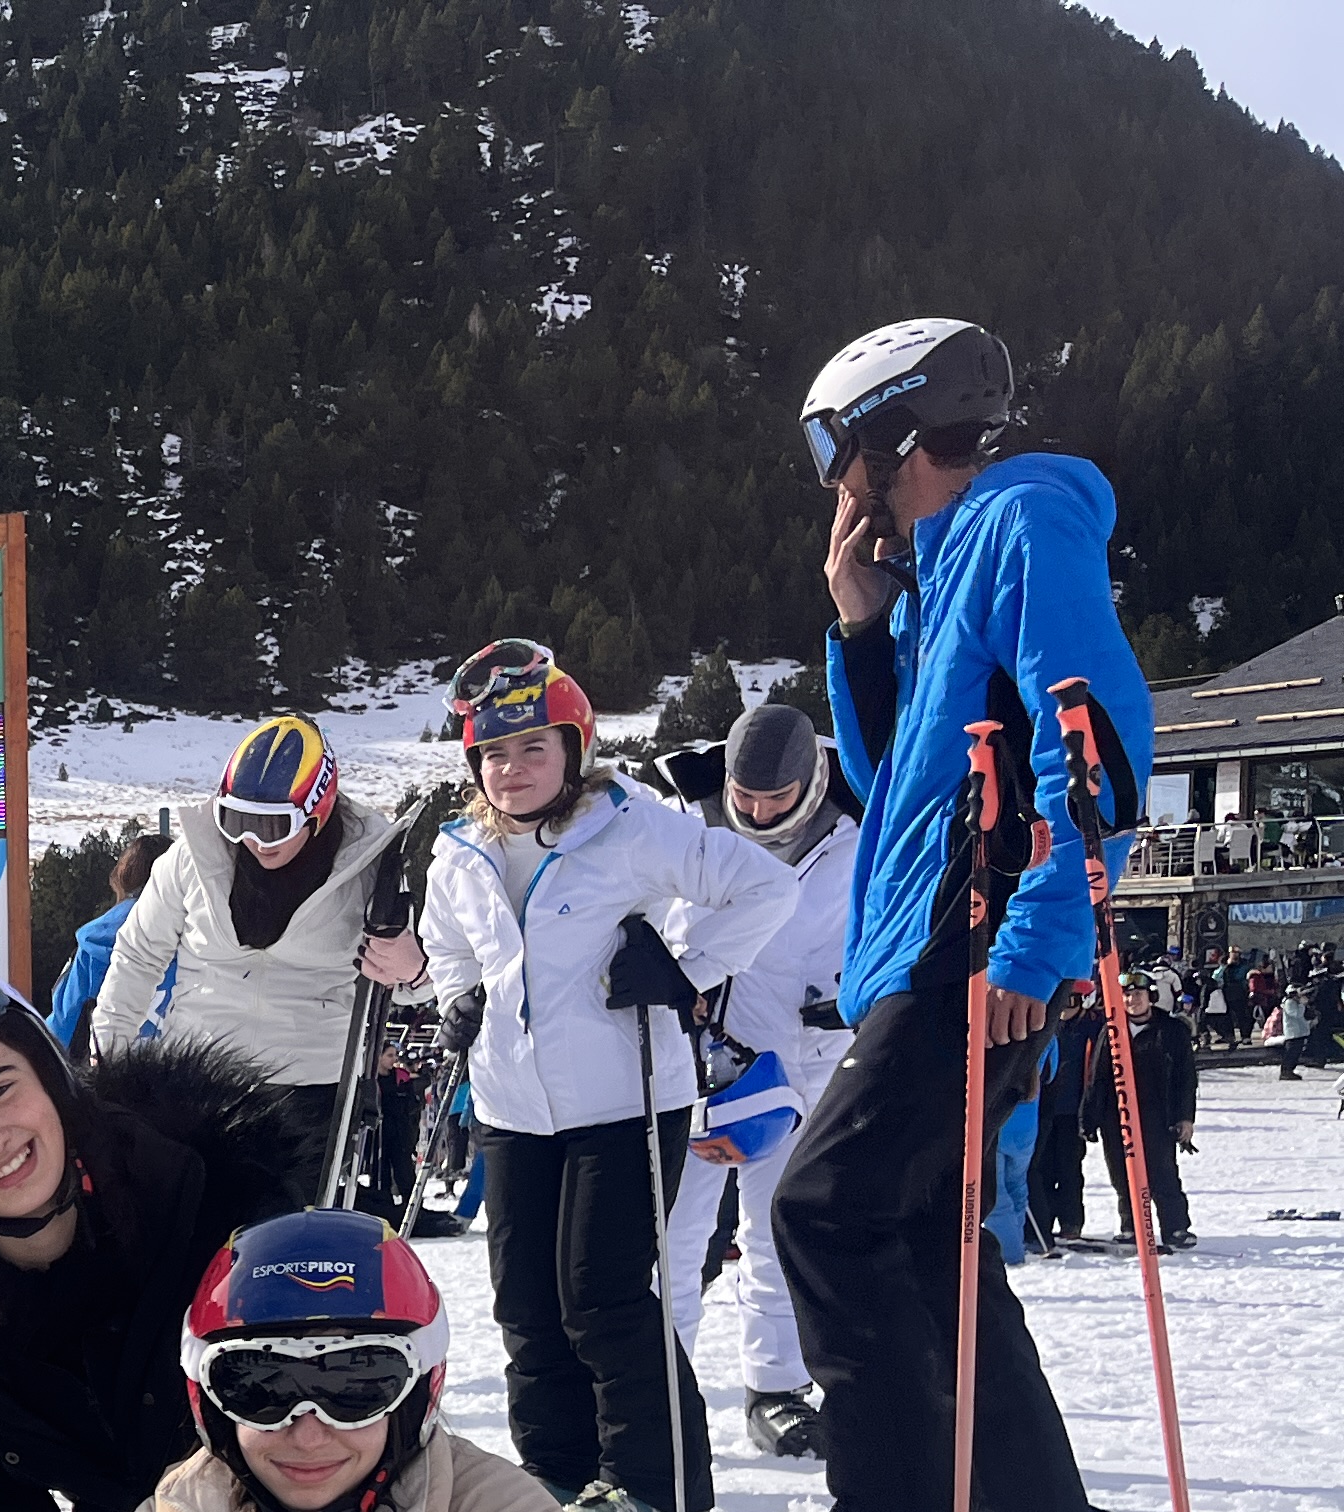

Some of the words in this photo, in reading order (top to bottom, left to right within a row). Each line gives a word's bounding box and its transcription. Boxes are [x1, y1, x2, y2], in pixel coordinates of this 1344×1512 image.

[841, 374, 928, 427] HEAD
[964, 1180, 976, 1244] ROSSIGNOL
[252, 1261, 356, 1279] ESPORTSPIROT
